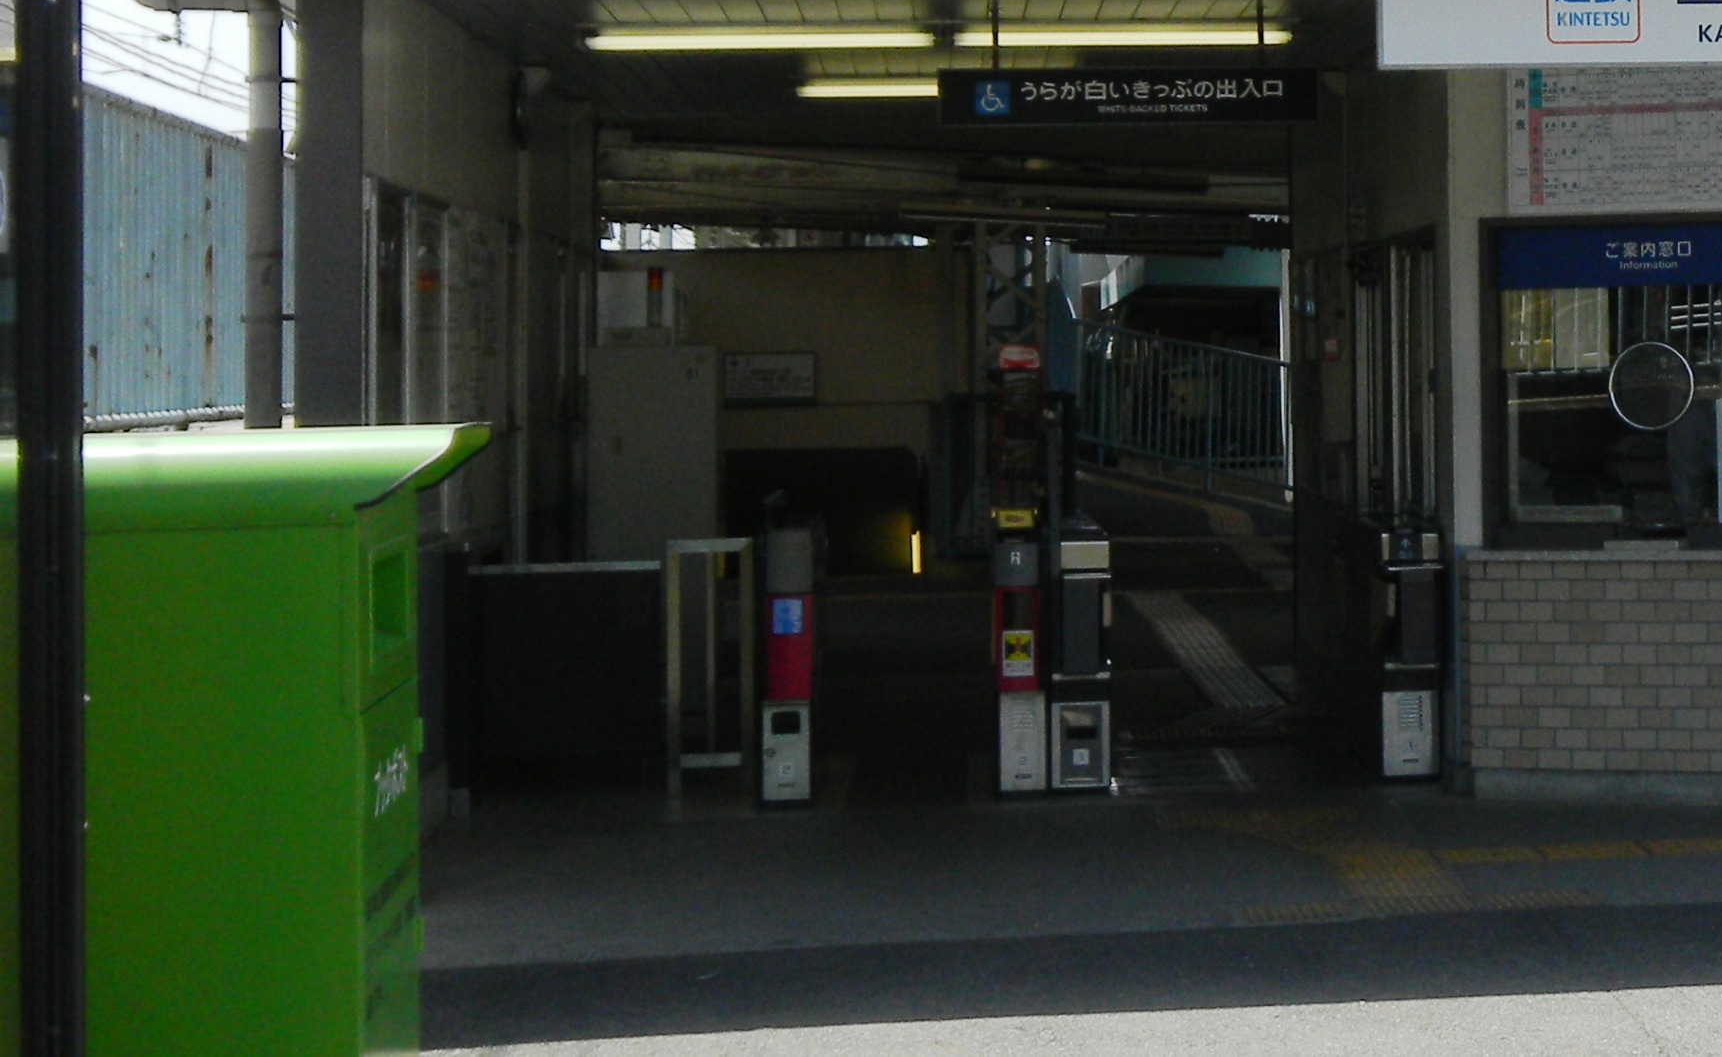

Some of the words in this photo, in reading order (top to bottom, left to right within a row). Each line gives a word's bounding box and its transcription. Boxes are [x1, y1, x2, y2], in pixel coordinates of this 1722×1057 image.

[1557, 11, 1630, 27] KINTETSU
[1020, 78, 1283, 102] うらが白いきっぷの出入口
[1169, 103, 1208, 113] TICKETS
[1605, 241, 1692, 258] ご案内窓口
[1619, 260, 1678, 270] Information
